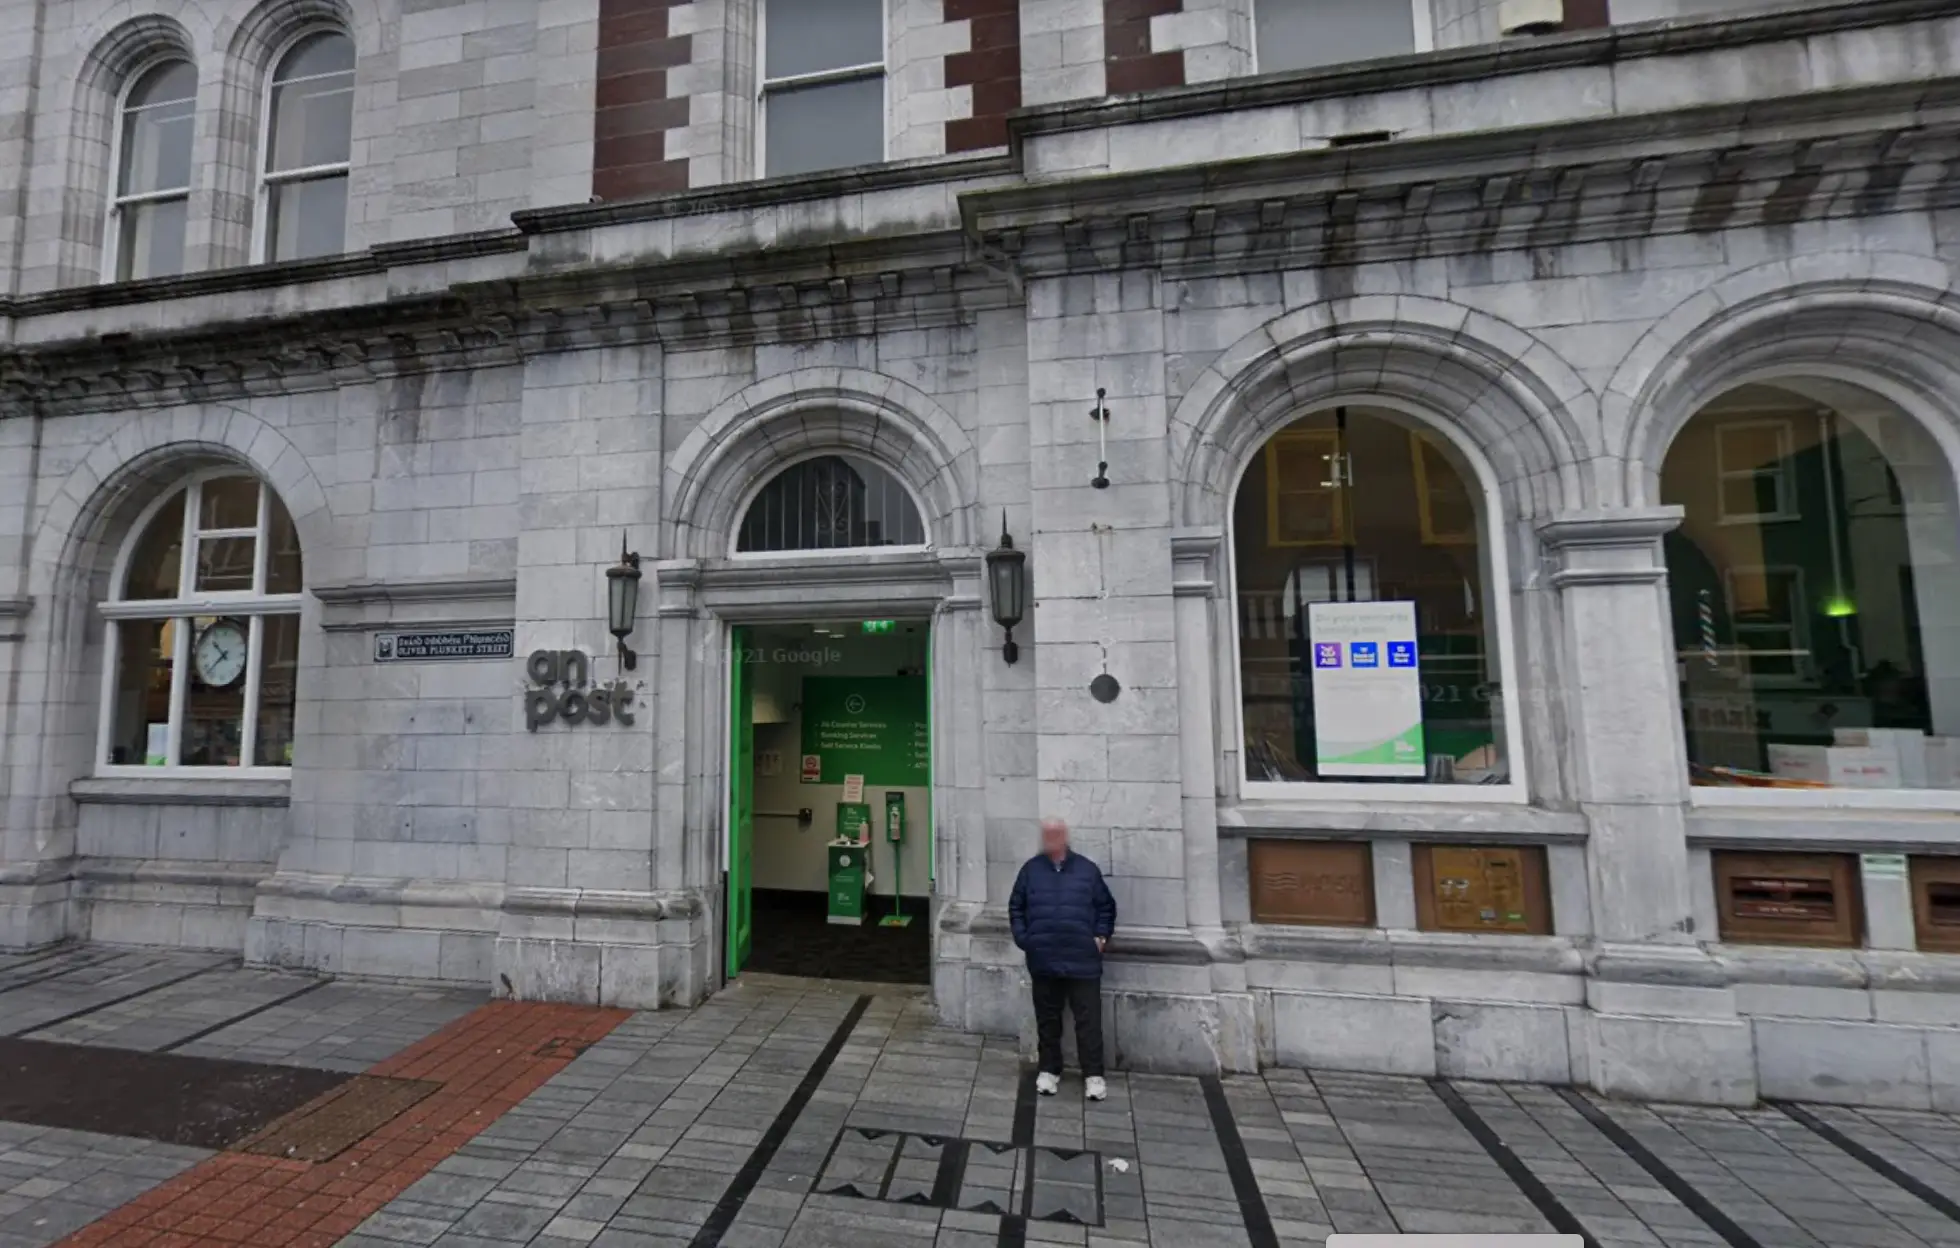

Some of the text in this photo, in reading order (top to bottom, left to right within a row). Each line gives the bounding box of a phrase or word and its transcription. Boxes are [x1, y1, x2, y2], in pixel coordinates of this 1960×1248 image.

[398, 644, 509, 655] OLIVER PLUNKETT STREET
[526, 650, 587, 689] an
[525, 681, 634, 733] post
